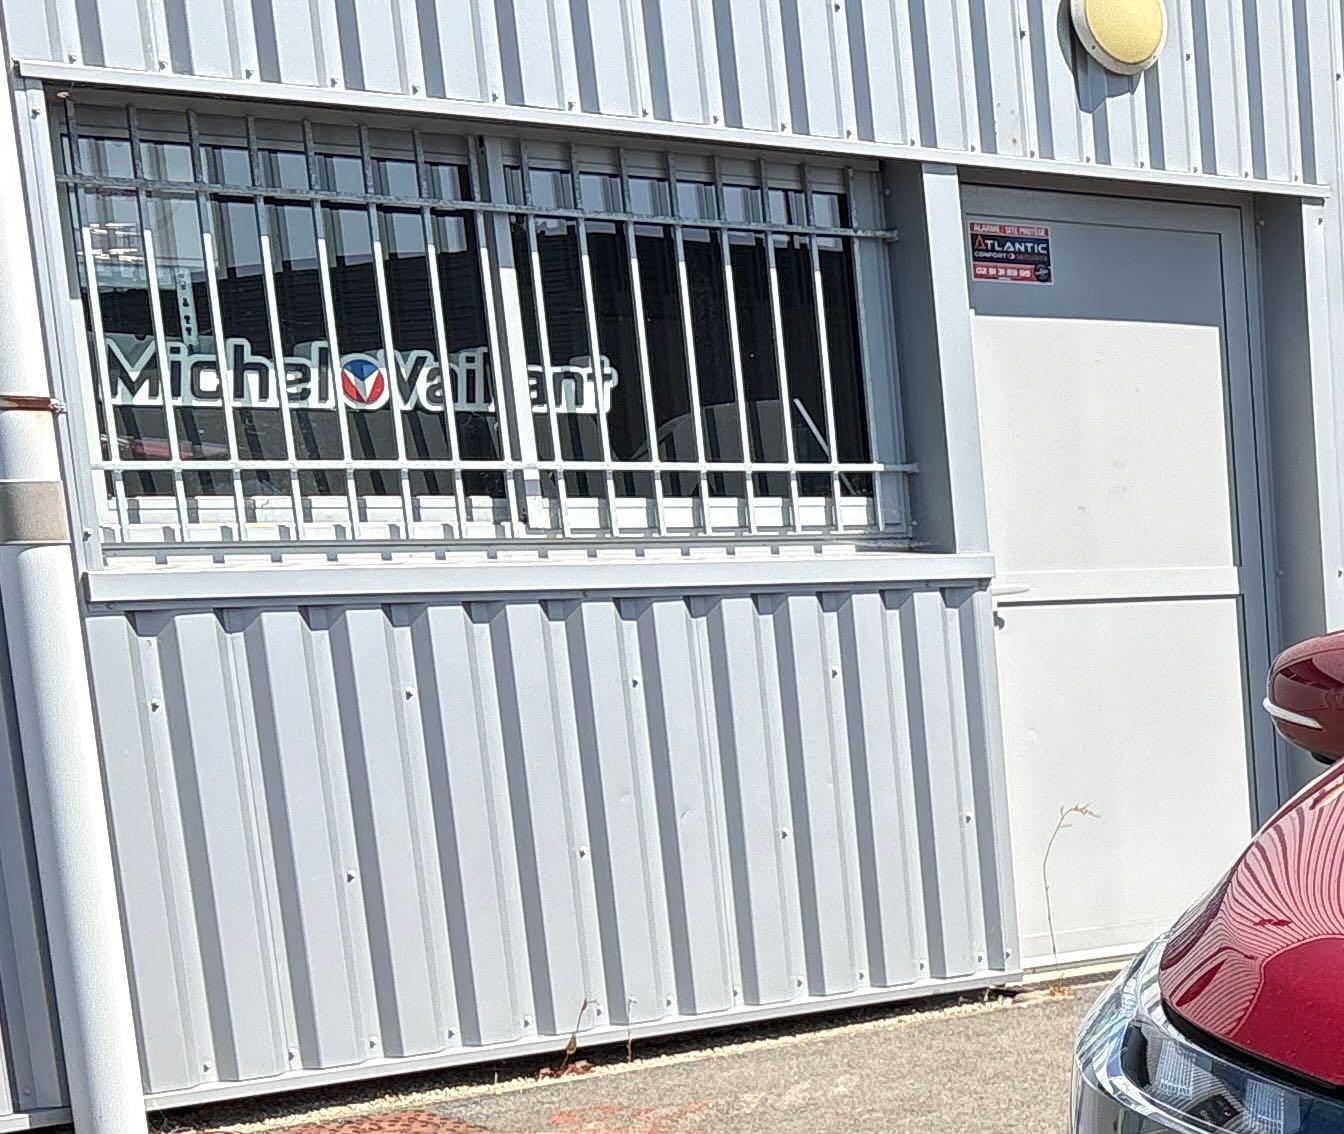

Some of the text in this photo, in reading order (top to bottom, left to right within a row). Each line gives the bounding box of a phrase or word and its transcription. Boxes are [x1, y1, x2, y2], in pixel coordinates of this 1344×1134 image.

[975, 235, 1048, 254] ATLANTIC
[107, 342, 616, 410] Michel Vailant
